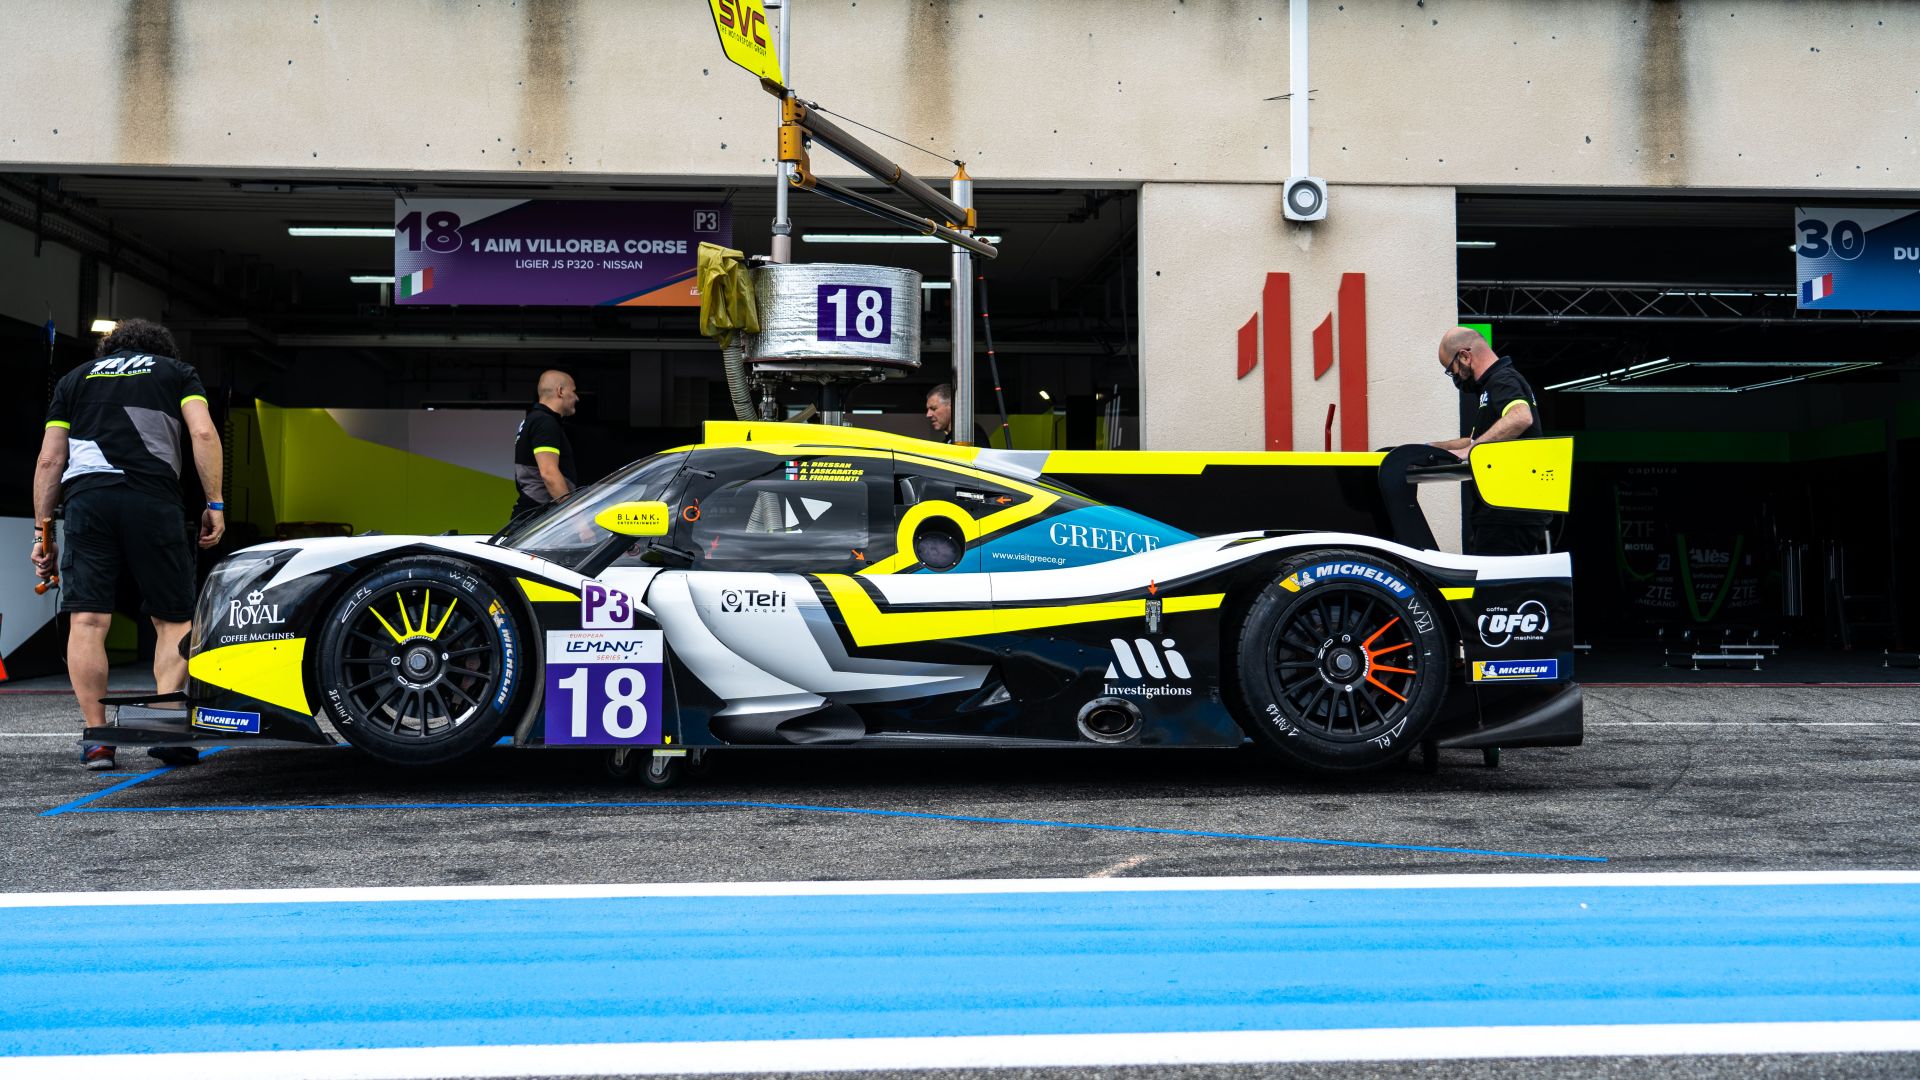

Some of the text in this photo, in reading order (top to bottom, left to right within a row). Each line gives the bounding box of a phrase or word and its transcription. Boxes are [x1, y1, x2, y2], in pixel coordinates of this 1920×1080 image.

[719, 0, 766, 47] SVC
[396, 210, 463, 254] 18
[695, 212, 718, 231] P3
[470, 238, 687, 254] 1 AIM VILLORBA CORSE
[1797, 219, 1865, 260] 30
[516, 260, 548, 269] LIGIER
[551, 260, 564, 269] JS
[567, 260, 594, 269] P320
[603, 260, 643, 270] NISSAN
[826, 288, 884, 339] 18
[1237, 272, 1369, 451] 11
[809, 468, 864, 476] LASKARATOS
[811, 461, 852, 469] BRESSAN
[1049, 522, 1160, 554] GREECE
[991, 551, 1066, 566] www.visitgreece.gr
[1315, 563, 1407, 594] MICHELIN
[585, 584, 630, 623] P3
[744, 589, 786, 607] Teti
[228, 599, 286, 629] ROYAL
[1488, 613, 1539, 633] BFC
[498, 628, 515, 705] MICHELIN
[1498, 665, 1549, 675] MICHELIN
[558, 667, 648, 739] 18
[1103, 683, 1192, 699] Investigations
[203, 714, 250, 727] MICHELIN
